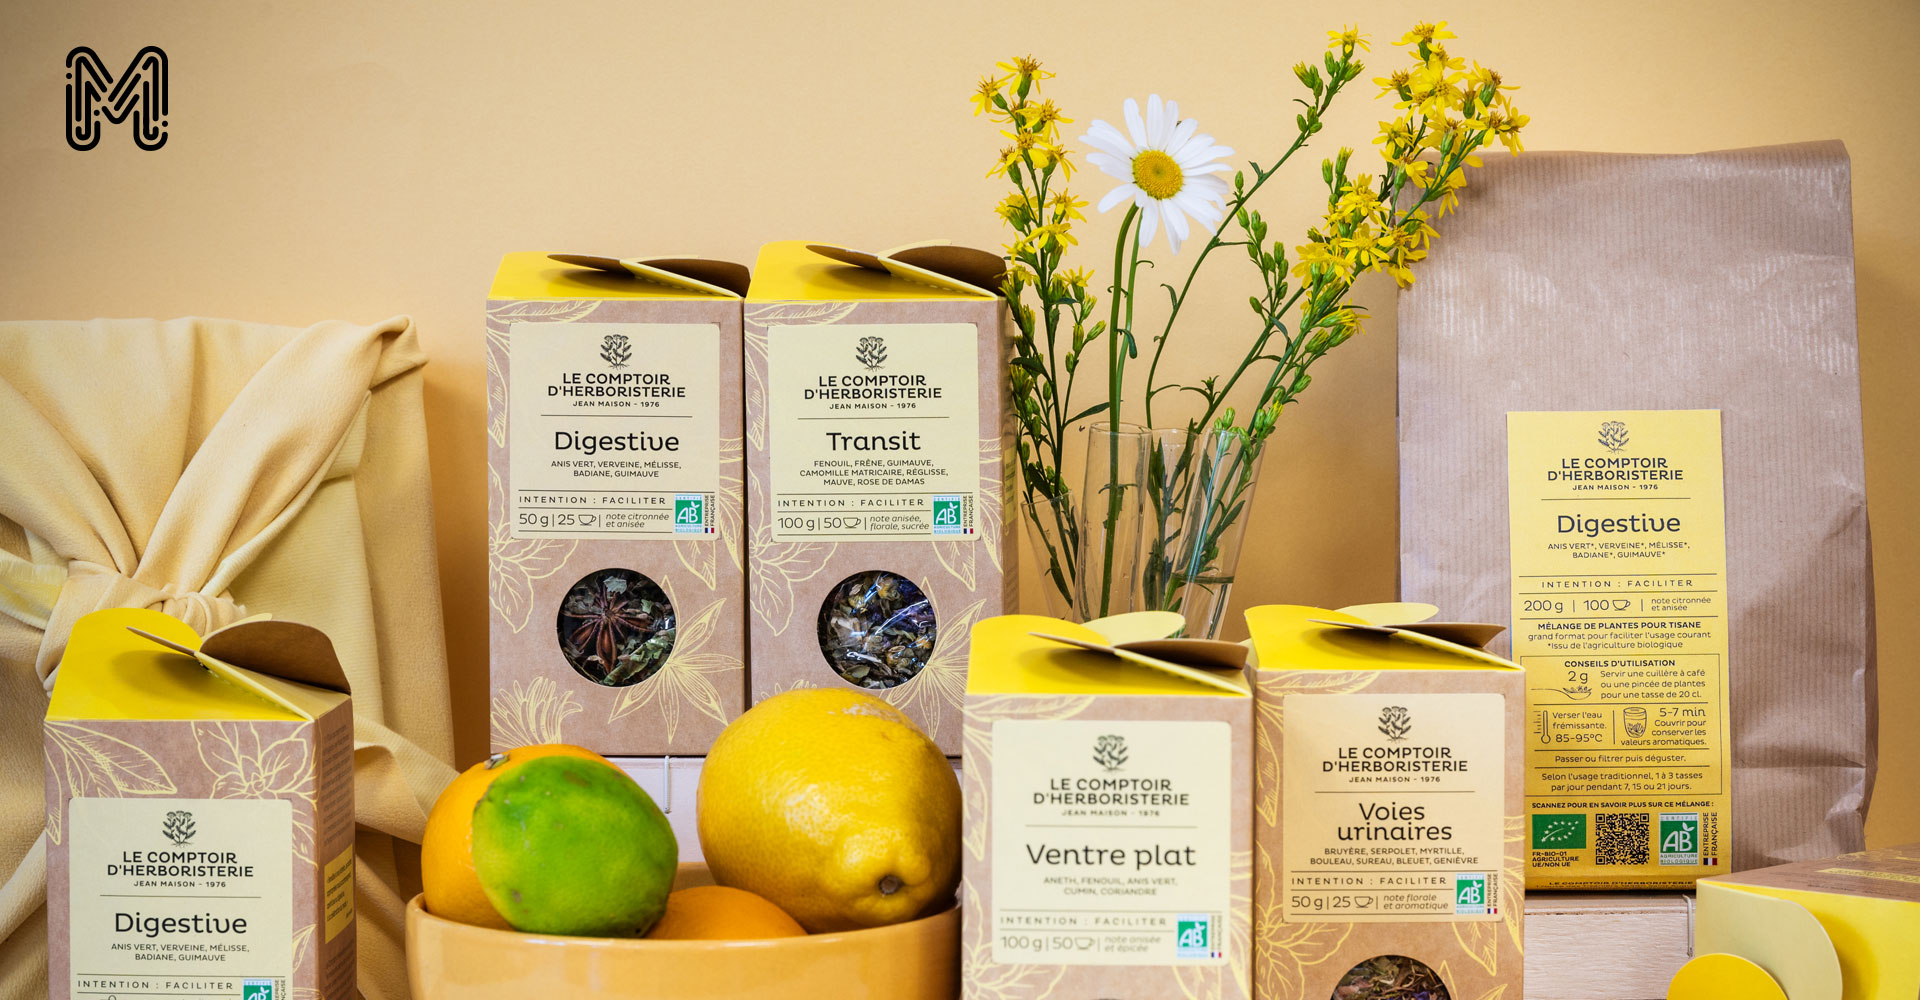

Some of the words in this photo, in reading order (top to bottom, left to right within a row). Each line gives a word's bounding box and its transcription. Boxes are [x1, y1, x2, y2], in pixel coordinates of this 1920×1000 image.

[563, 373, 581, 384] LE
[586, 373, 671, 385] COMPTOIR
[819, 376, 837, 387] LE
[842, 375, 927, 387] COMPTOIR
[548, 386, 686, 398] D'HERBORISTERIE
[805, 388, 942, 400] D'HERBORISTERIE
[556, 431, 679, 455] Digestive
[826, 431, 921, 451] Transit
[598, 461, 642, 469] VERVEINE,
[644, 460, 682, 469] MÉLISSE,
[814, 460, 853, 468] FENOUIL,
[855, 459, 885, 467] FRÊNE,
[1562, 458, 1580, 469] LE
[1585, 458, 1668, 469] COMPTOIR
[574, 470, 613, 478] BADIANE,
[907, 466, 948, 476] RÉGLISSE,
[1548, 470, 1683, 481] D'HERBORISTERIE
[520, 496, 587, 504] INTENTION
[677, 507, 699, 524] AB
[935, 508, 957, 524] AB
[1558, 513, 1680, 538] Digestive
[1538, 622, 1582, 630] MÉLANGE
[1565, 660, 1609, 668] CONSEILS
[1568, 671, 1576, 682] 2
[1580, 673, 1588, 684] g
[1687, 669, 1706, 677] café
[1632, 681, 1660, 689] pincée
[1660, 708, 1679, 717] 5-7
[1683, 707, 1706, 717] min
[1553, 722, 1607, 730] frémissante.
[1621, 737, 1651, 746] valeurs
[1652, 738, 1707, 746] aromatiques.
[1339, 748, 1358, 759] LE
[1363, 747, 1452, 759] COMPTOIR
[1626, 755, 1643, 763] puis
[1645, 754, 1686, 763] déguster.
[1323, 761, 1468, 772] D'HERBORISTERIE
[1542, 773, 1566, 781] Selon
[1568, 773, 1599, 782] l'usage
[1600, 772, 1654, 780] traditionnel,
[1661, 772, 1666, 780] à
[1051, 778, 1070, 790] LE
[1077, 778, 1172, 791] COMPTOIR
[1567, 784, 1585, 792] jour
[1586, 784, 1622, 792] pendant
[1624, 783, 1630, 791] 7,
[1668, 783, 1692, 791] jours.
[1034, 793, 1189, 805] D'HERBORISTERIE
[1359, 802, 1425, 821] Voies
[1338, 822, 1452, 841] urinaires
[1663, 831, 1693, 852] AB
[1325, 847, 1368, 856] BRUYÈRE,
[123, 851, 142, 863] LE
[147, 852, 237, 864] COMPTOIR
[1026, 844, 1125, 866] Ventre
[1134, 845, 1196, 871] plat
[1396, 857, 1432, 865] BLEUET,
[1434, 856, 1478, 864] GENIÈVRE
[108, 865, 253, 877] D'HERBORISTERIE
[1380, 877, 1446, 885] FACILITER
[1458, 886, 1481, 904] AB
[116, 912, 247, 938] Digestive
[1179, 925, 1205, 947] AB
[134, 944, 159, 952] VERT,
[160, 944, 207, 952] VERVEINE,
[210, 944, 249, 952] MÉLISSE,
[78, 981, 149, 989] INTENTION
[166, 982, 233, 990] FACILITER
